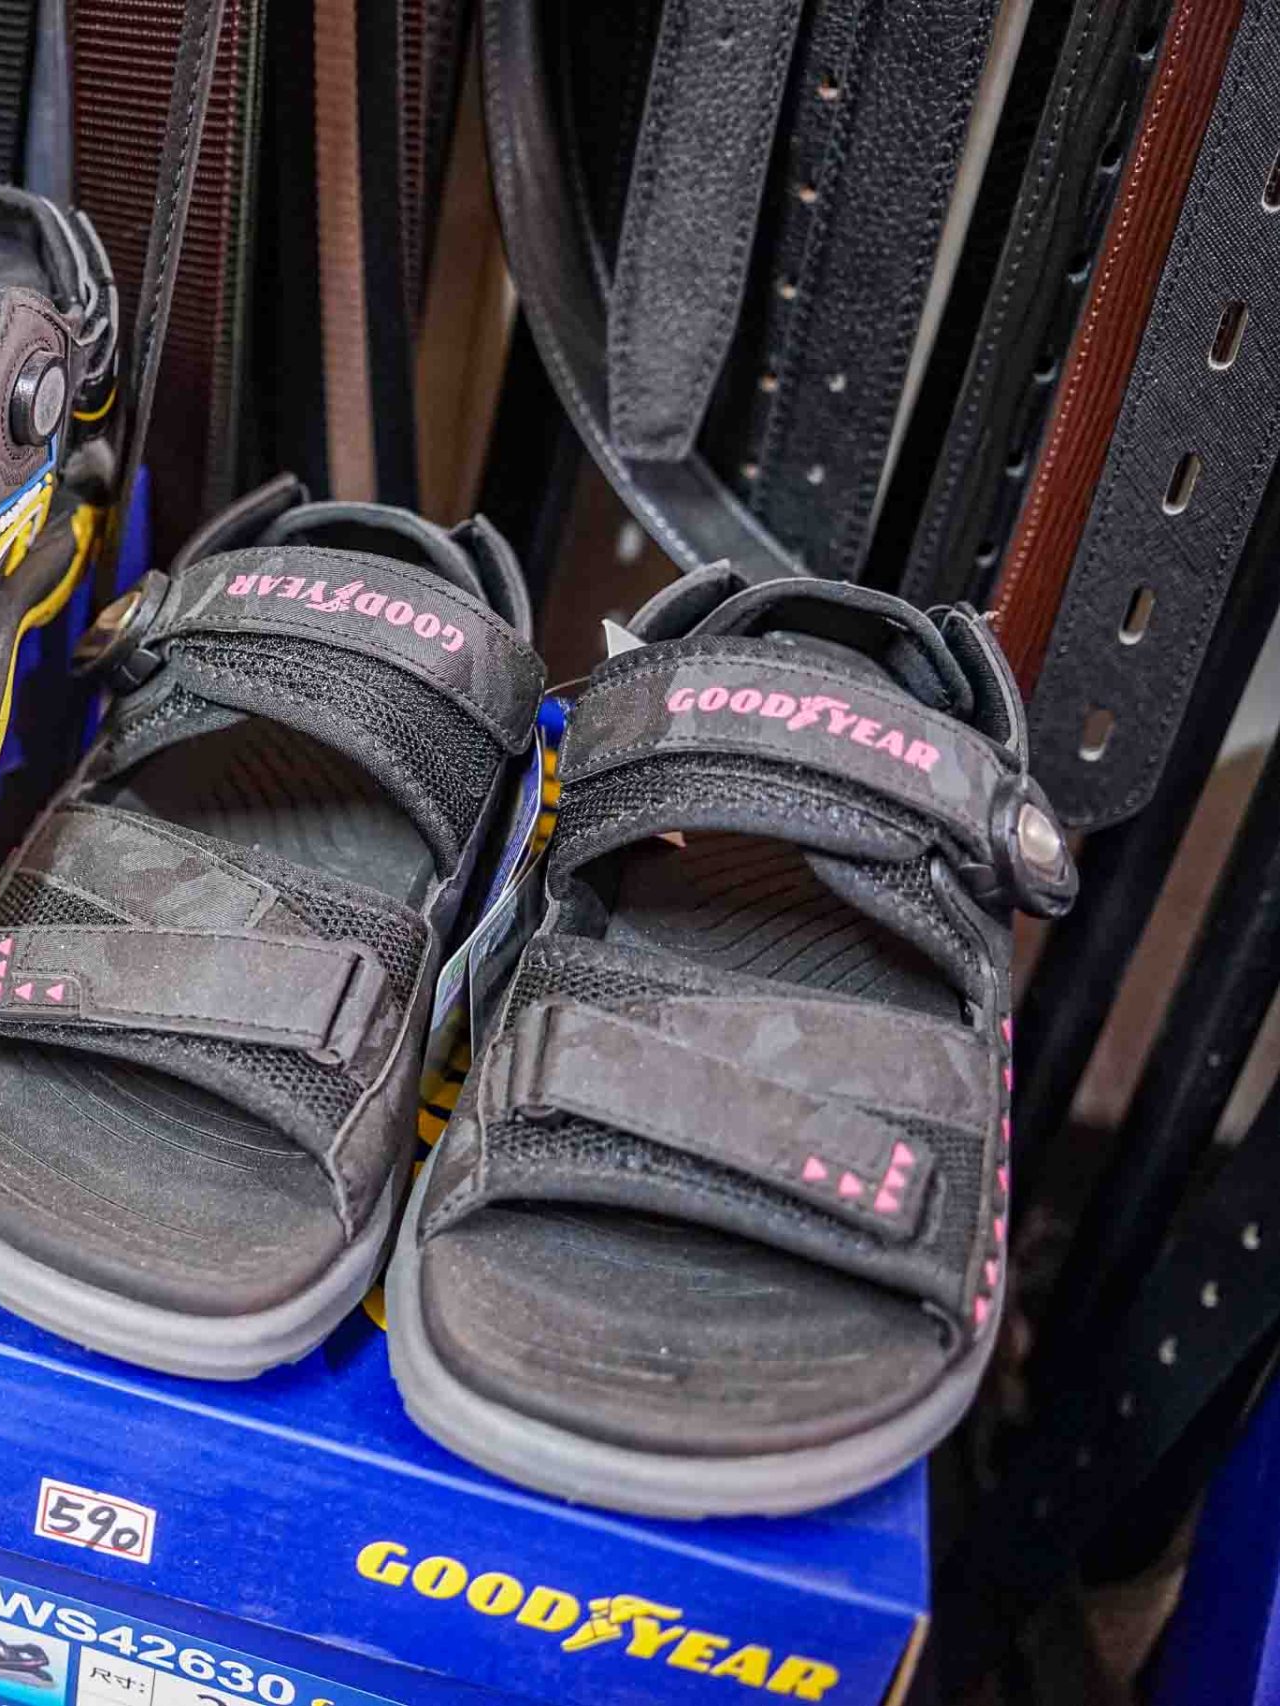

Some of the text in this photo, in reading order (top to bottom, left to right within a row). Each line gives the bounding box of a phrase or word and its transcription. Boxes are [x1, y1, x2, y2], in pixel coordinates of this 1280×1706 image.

[226, 575, 465, 652] GOODYEAR
[667, 687, 940, 772] GOODYEAR
[47, 1495, 141, 1552] 590
[356, 1540, 840, 1700] GOODYEAR
